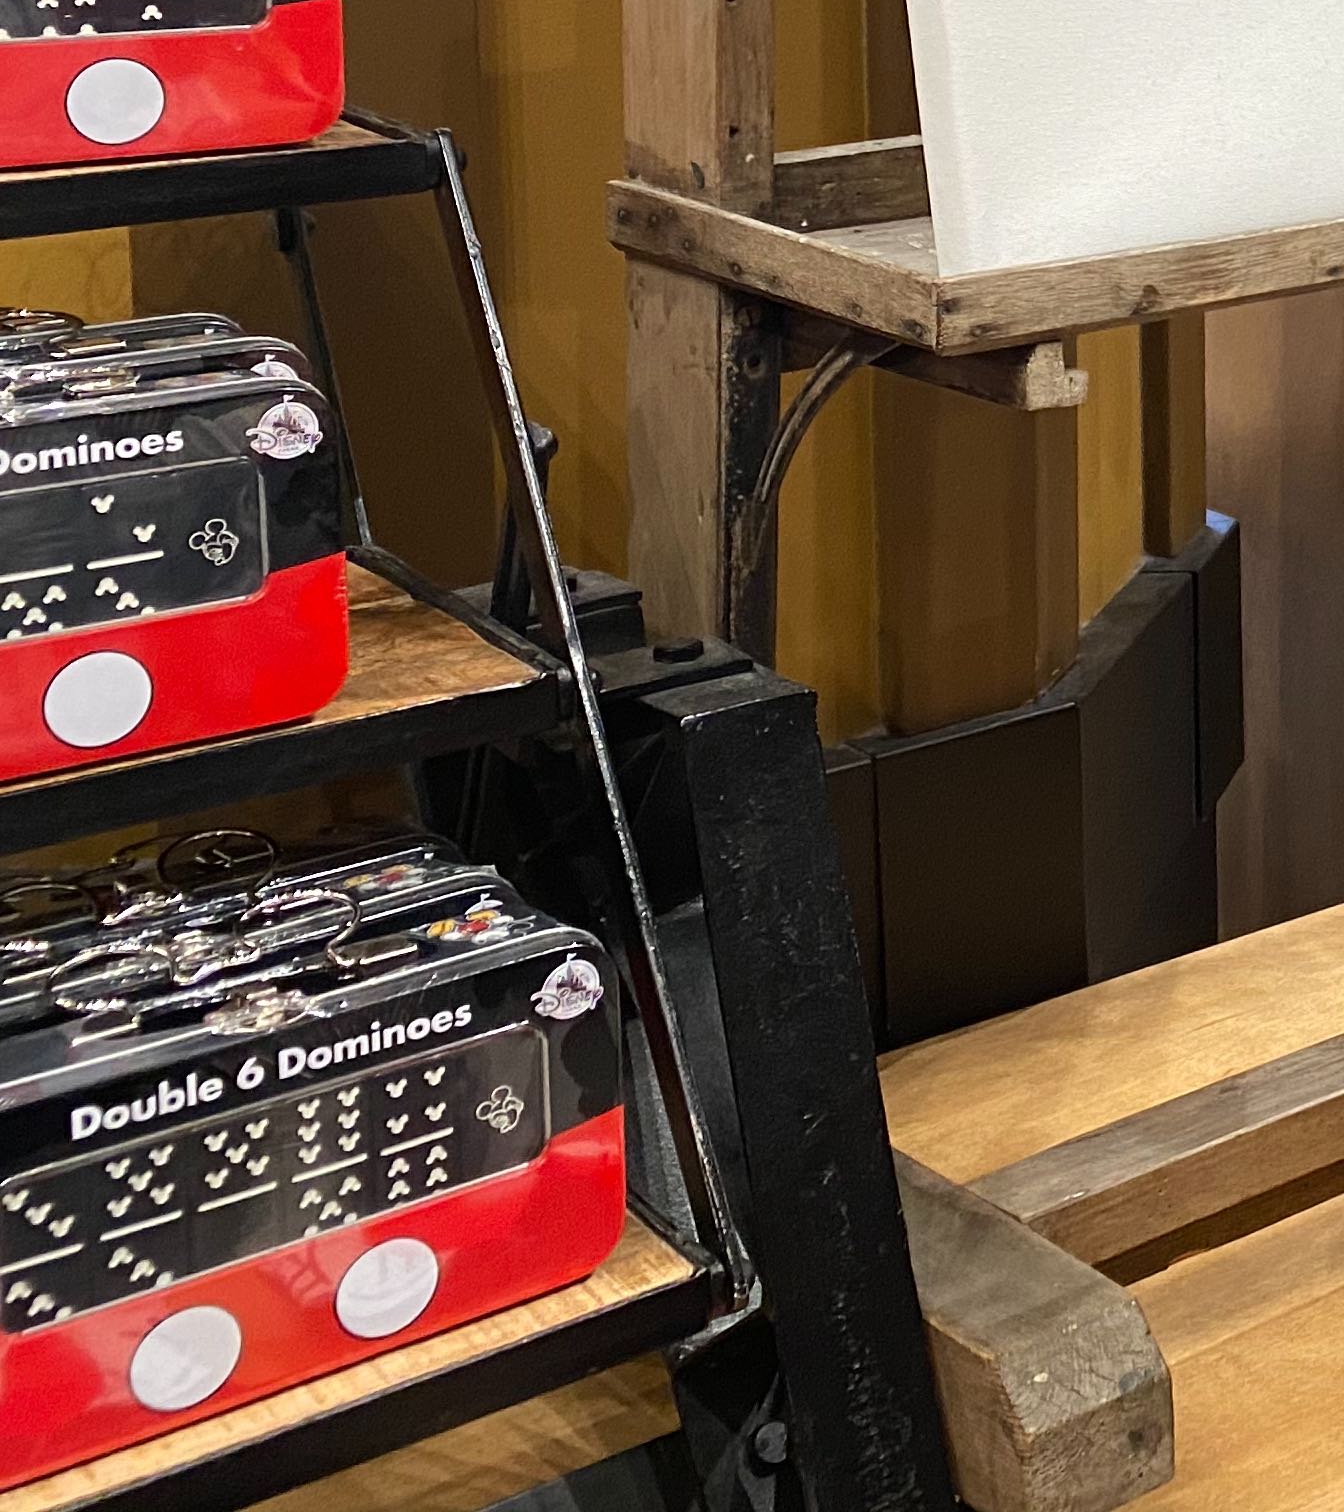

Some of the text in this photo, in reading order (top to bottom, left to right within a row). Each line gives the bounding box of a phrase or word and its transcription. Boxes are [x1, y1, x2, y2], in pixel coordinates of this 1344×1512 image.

[71, 1003, 473, 1140] Double 6 Dominoes
